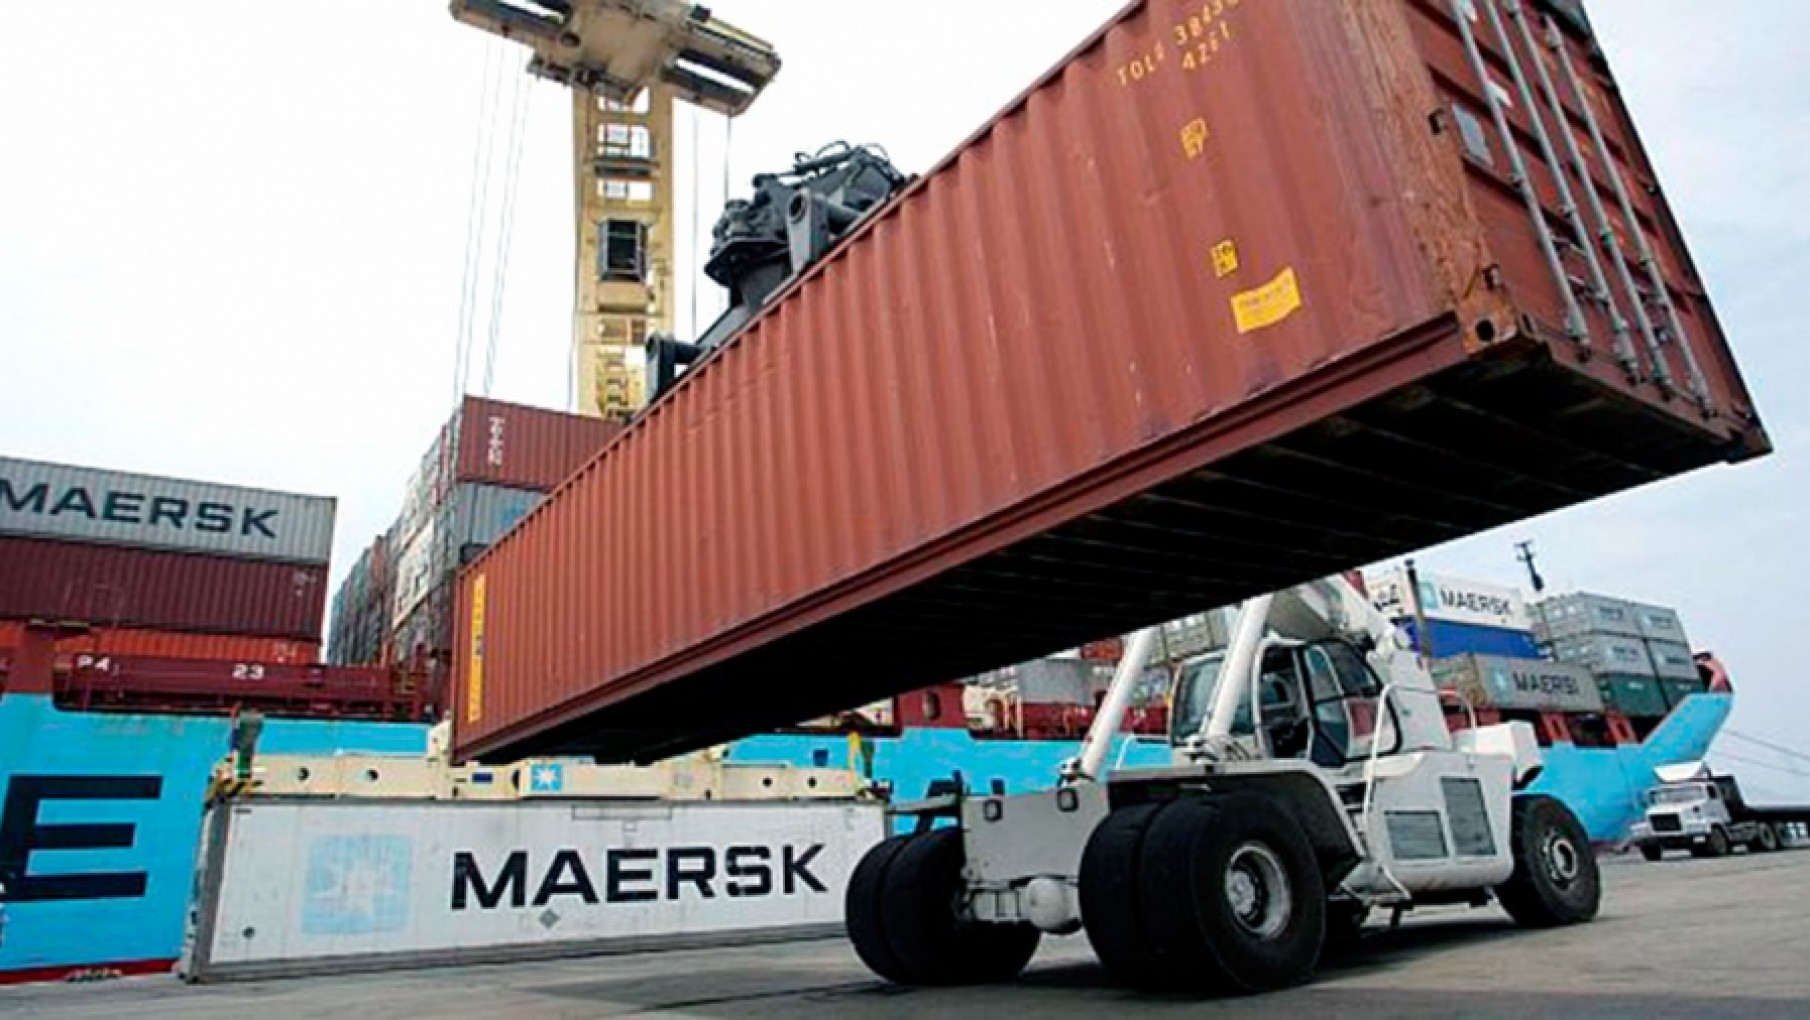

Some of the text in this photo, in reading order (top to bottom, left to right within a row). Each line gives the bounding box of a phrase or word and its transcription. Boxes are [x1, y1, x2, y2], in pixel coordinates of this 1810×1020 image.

[0, 479, 278, 538] MAERSK
[232, 664, 264, 680] 23
[451, 844, 828, 909] MAERSK
